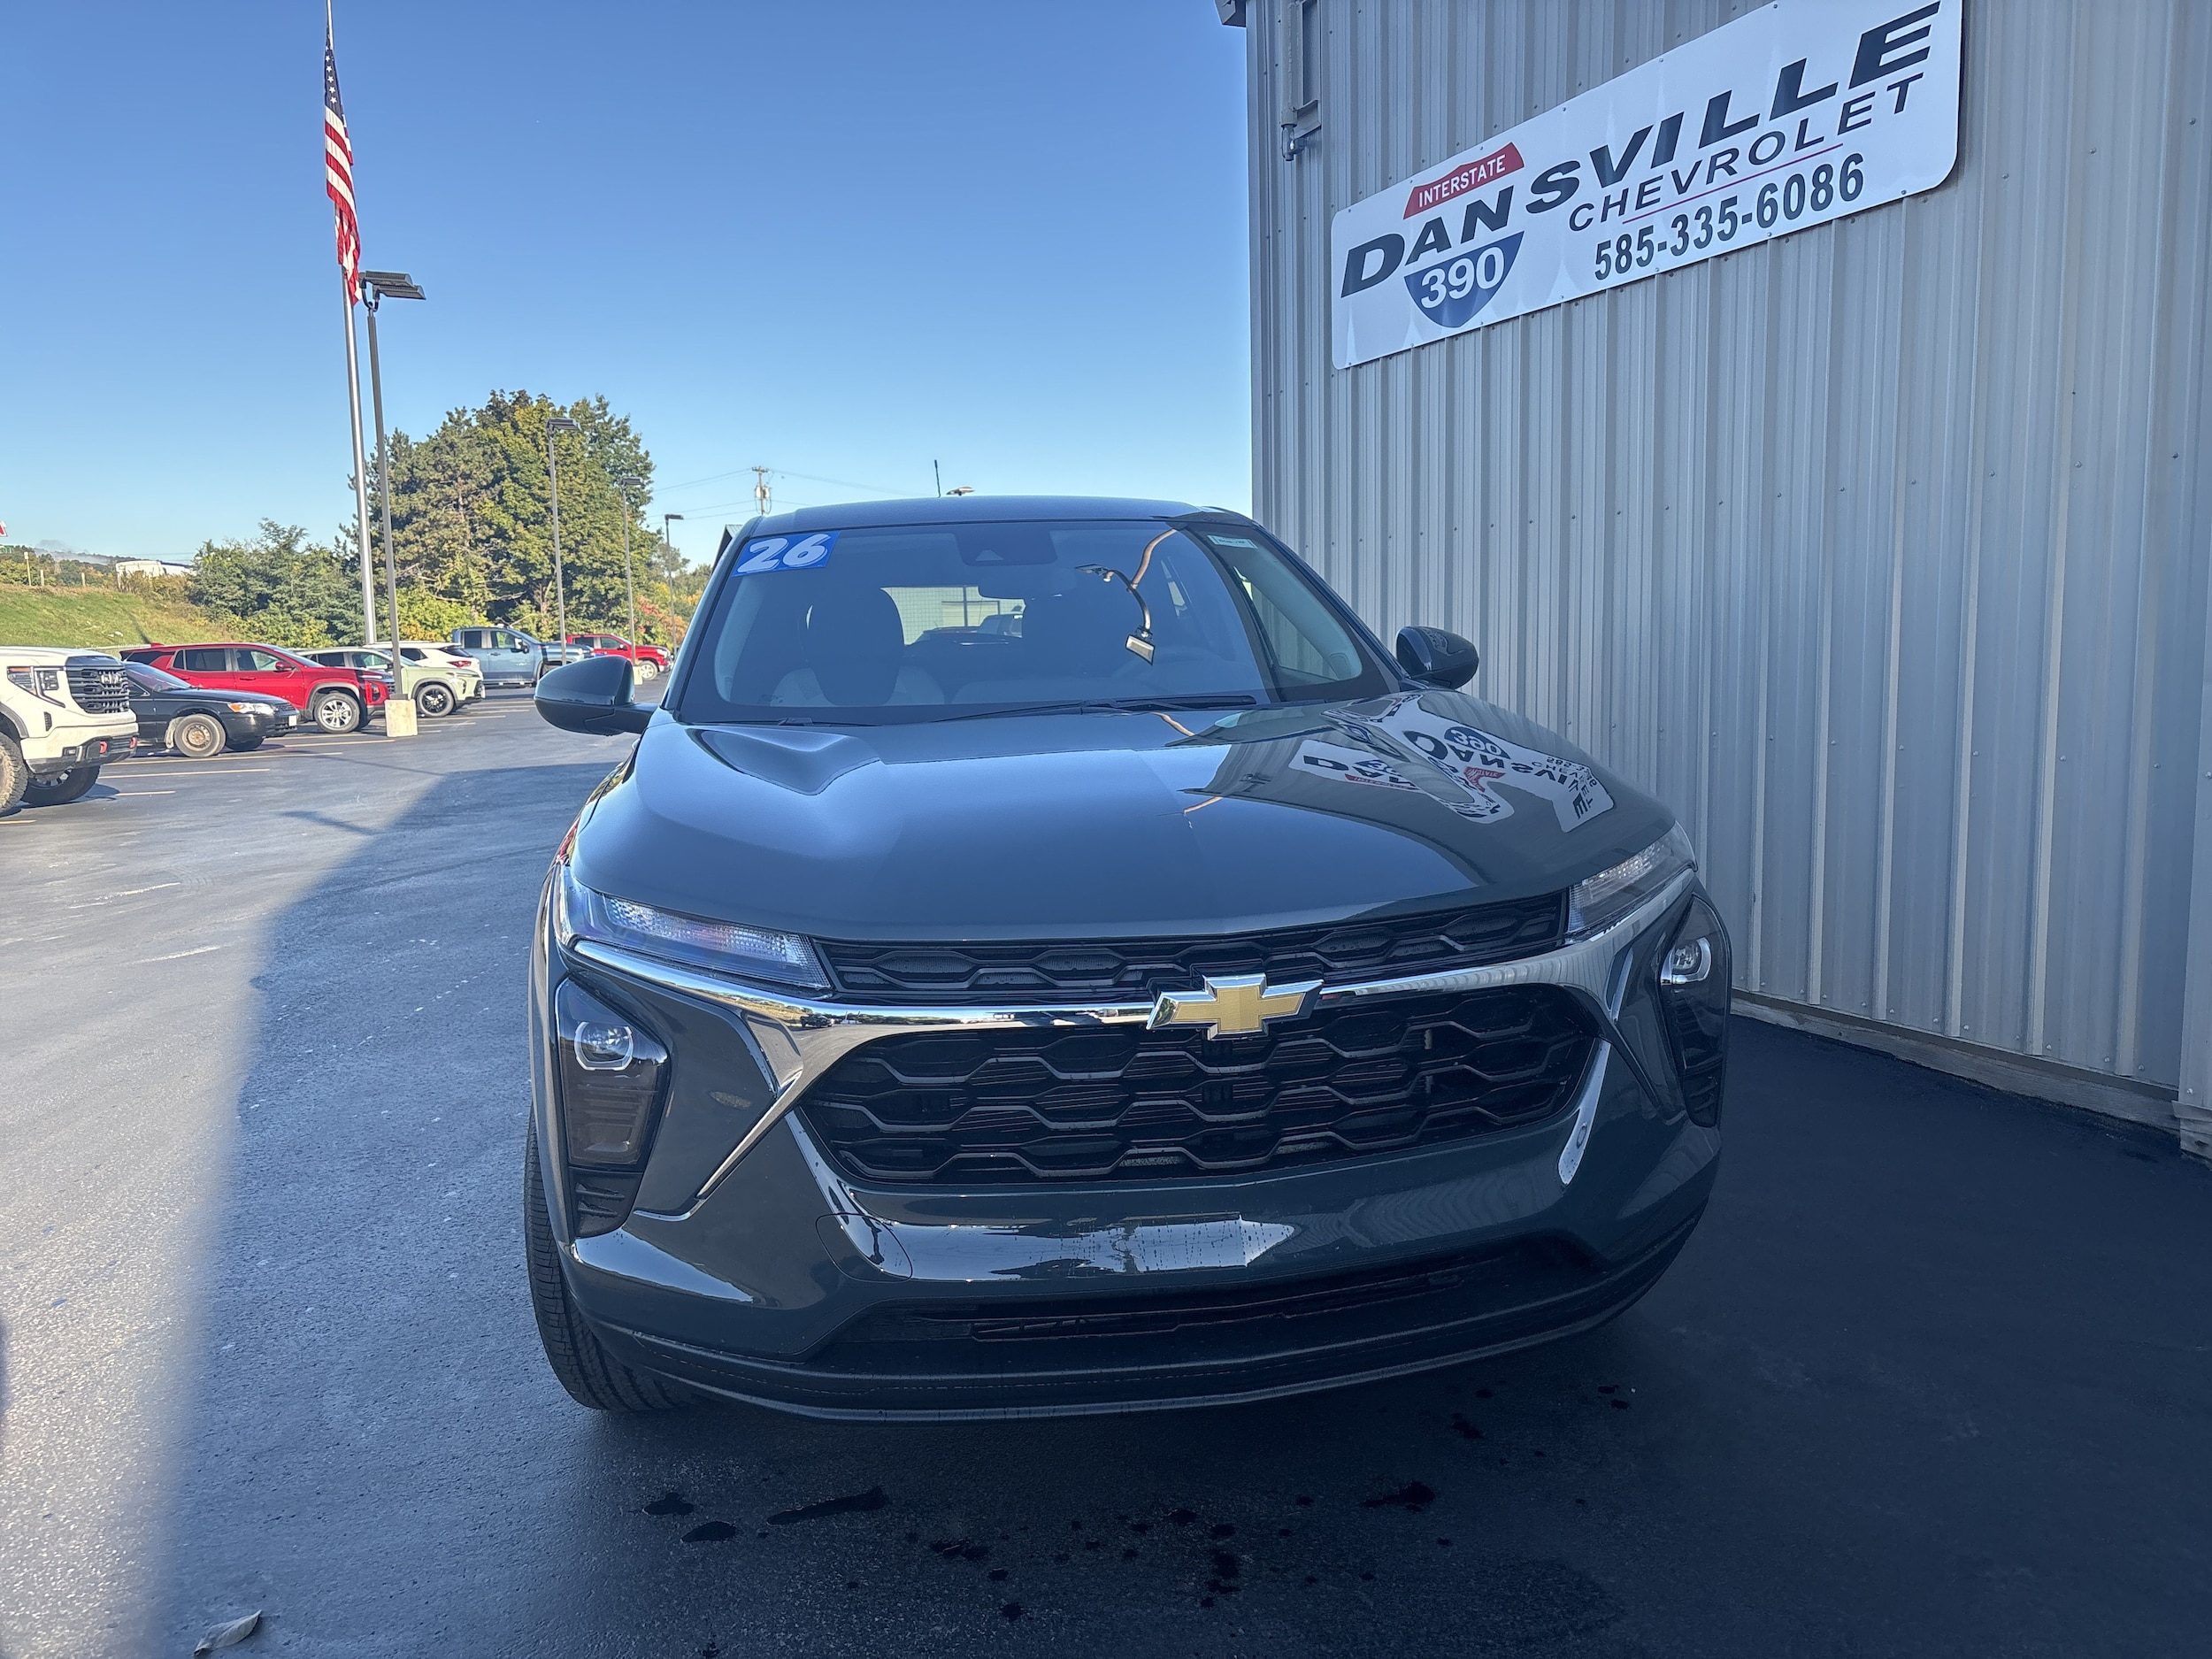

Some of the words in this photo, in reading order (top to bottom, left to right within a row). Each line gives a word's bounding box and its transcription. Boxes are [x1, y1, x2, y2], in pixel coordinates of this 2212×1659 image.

[1340, 1, 1941, 299] DANSVILLE
[1419, 154, 1506, 208] INTERSTATE
[1569, 73, 1924, 232] CHEVROLET
[1594, 152, 1864, 280] 585-335-6086
[1421, 246, 1505, 309] 390
[736, 533, 833, 574] 26
